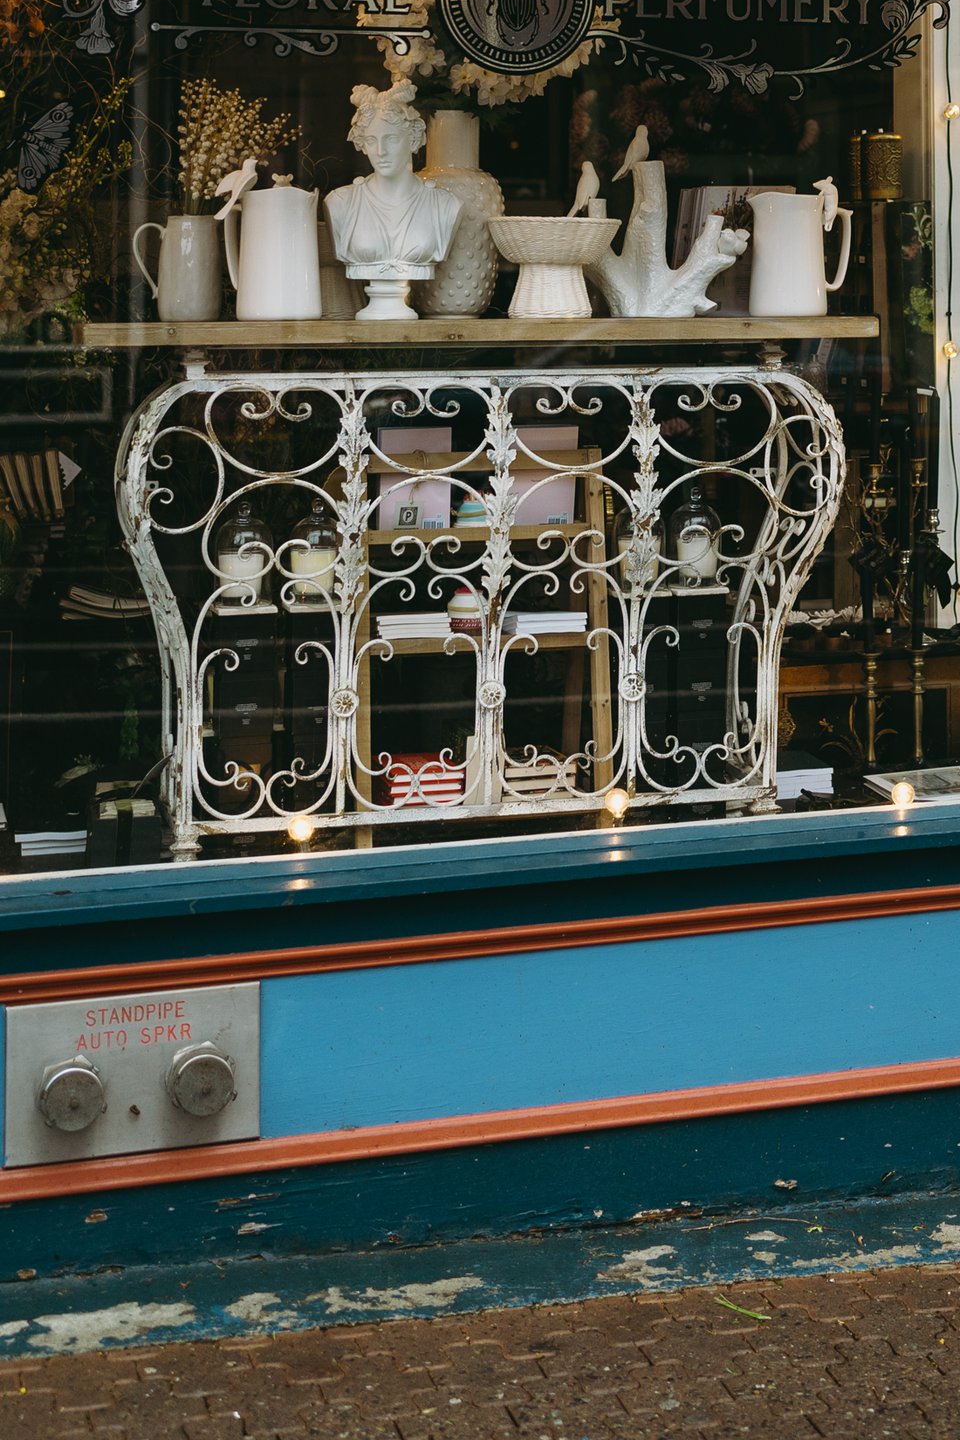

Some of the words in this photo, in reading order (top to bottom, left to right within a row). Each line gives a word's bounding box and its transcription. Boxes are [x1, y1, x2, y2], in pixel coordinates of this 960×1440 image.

[86, 1000, 186, 1027] STANDPIPE
[76, 1029, 127, 1051] AUTO
[140, 1023, 192, 1045] SPKR
